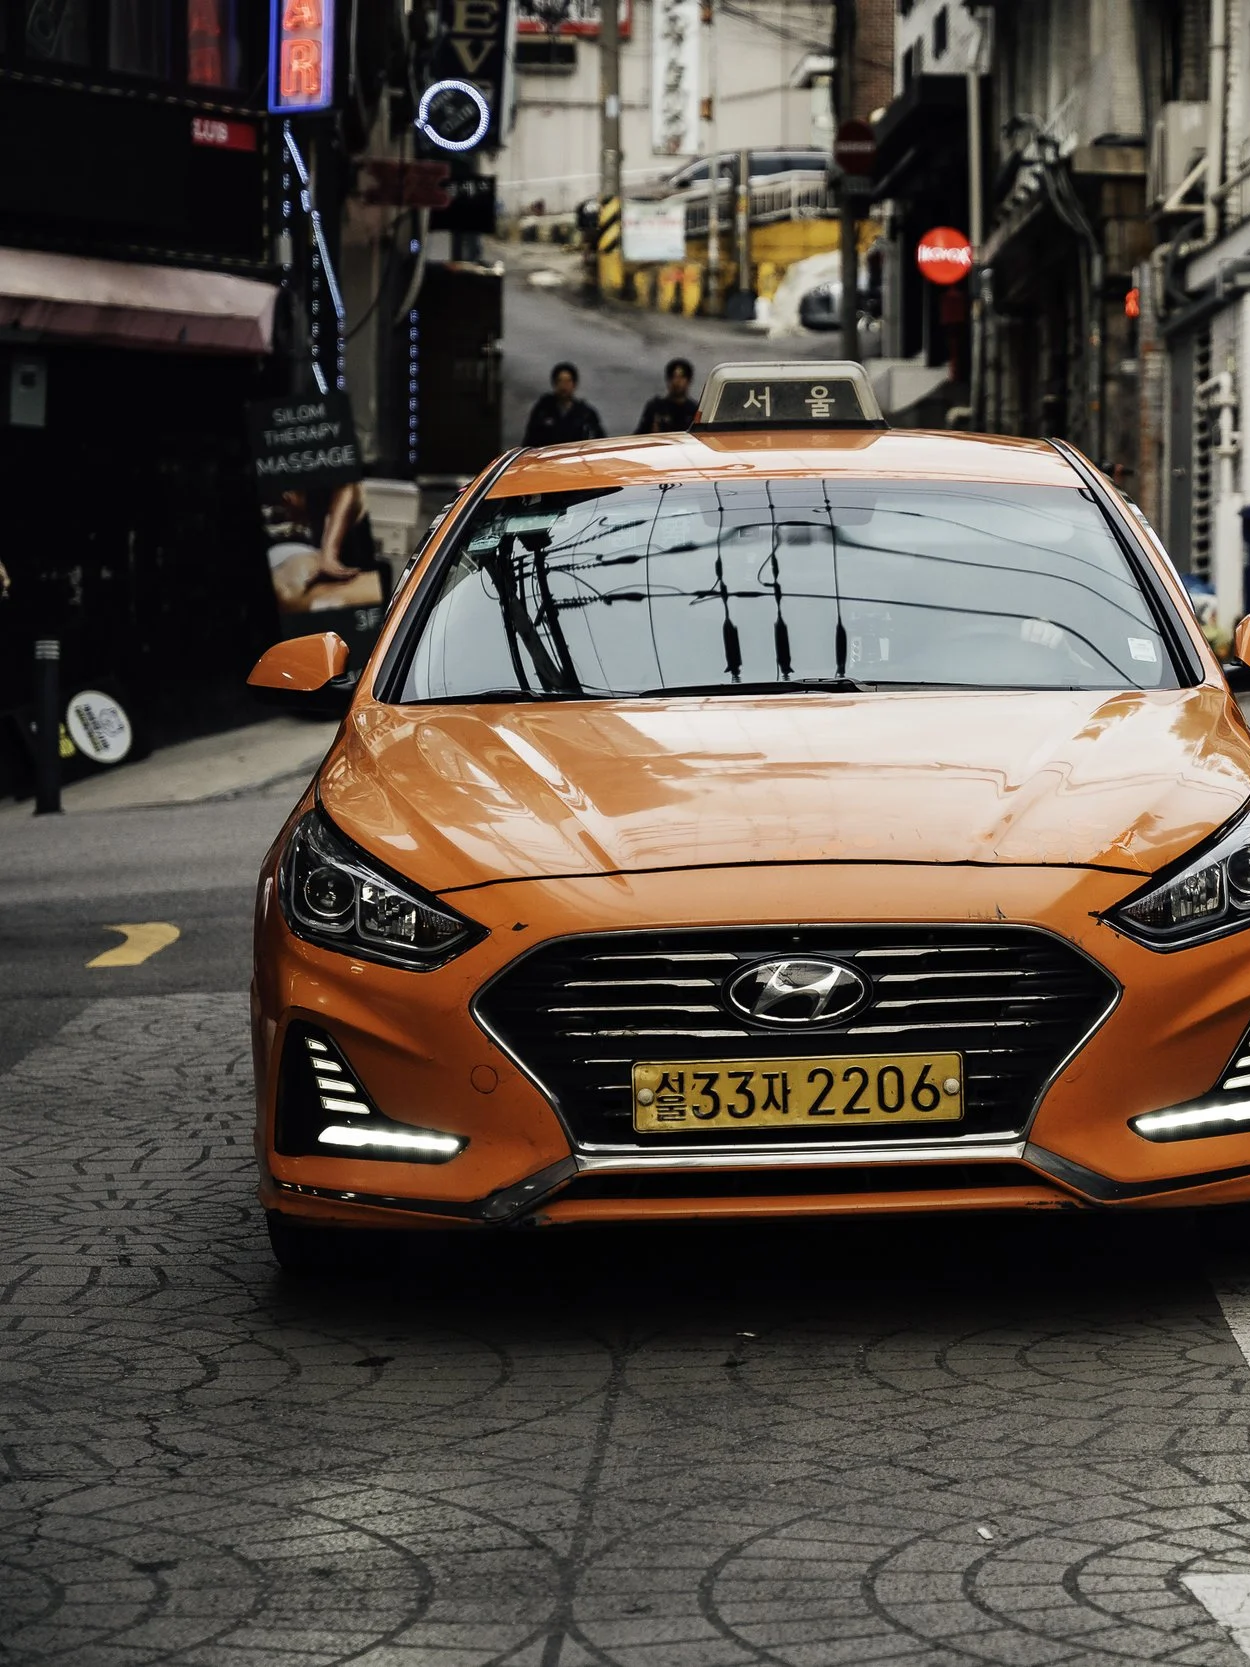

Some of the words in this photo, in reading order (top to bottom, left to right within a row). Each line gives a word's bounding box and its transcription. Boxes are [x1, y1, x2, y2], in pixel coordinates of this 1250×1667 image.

[263, 421, 342, 447] THERAPY
[255, 445, 357, 477] MASSAGE
[806, 1063, 941, 1116] 2206
